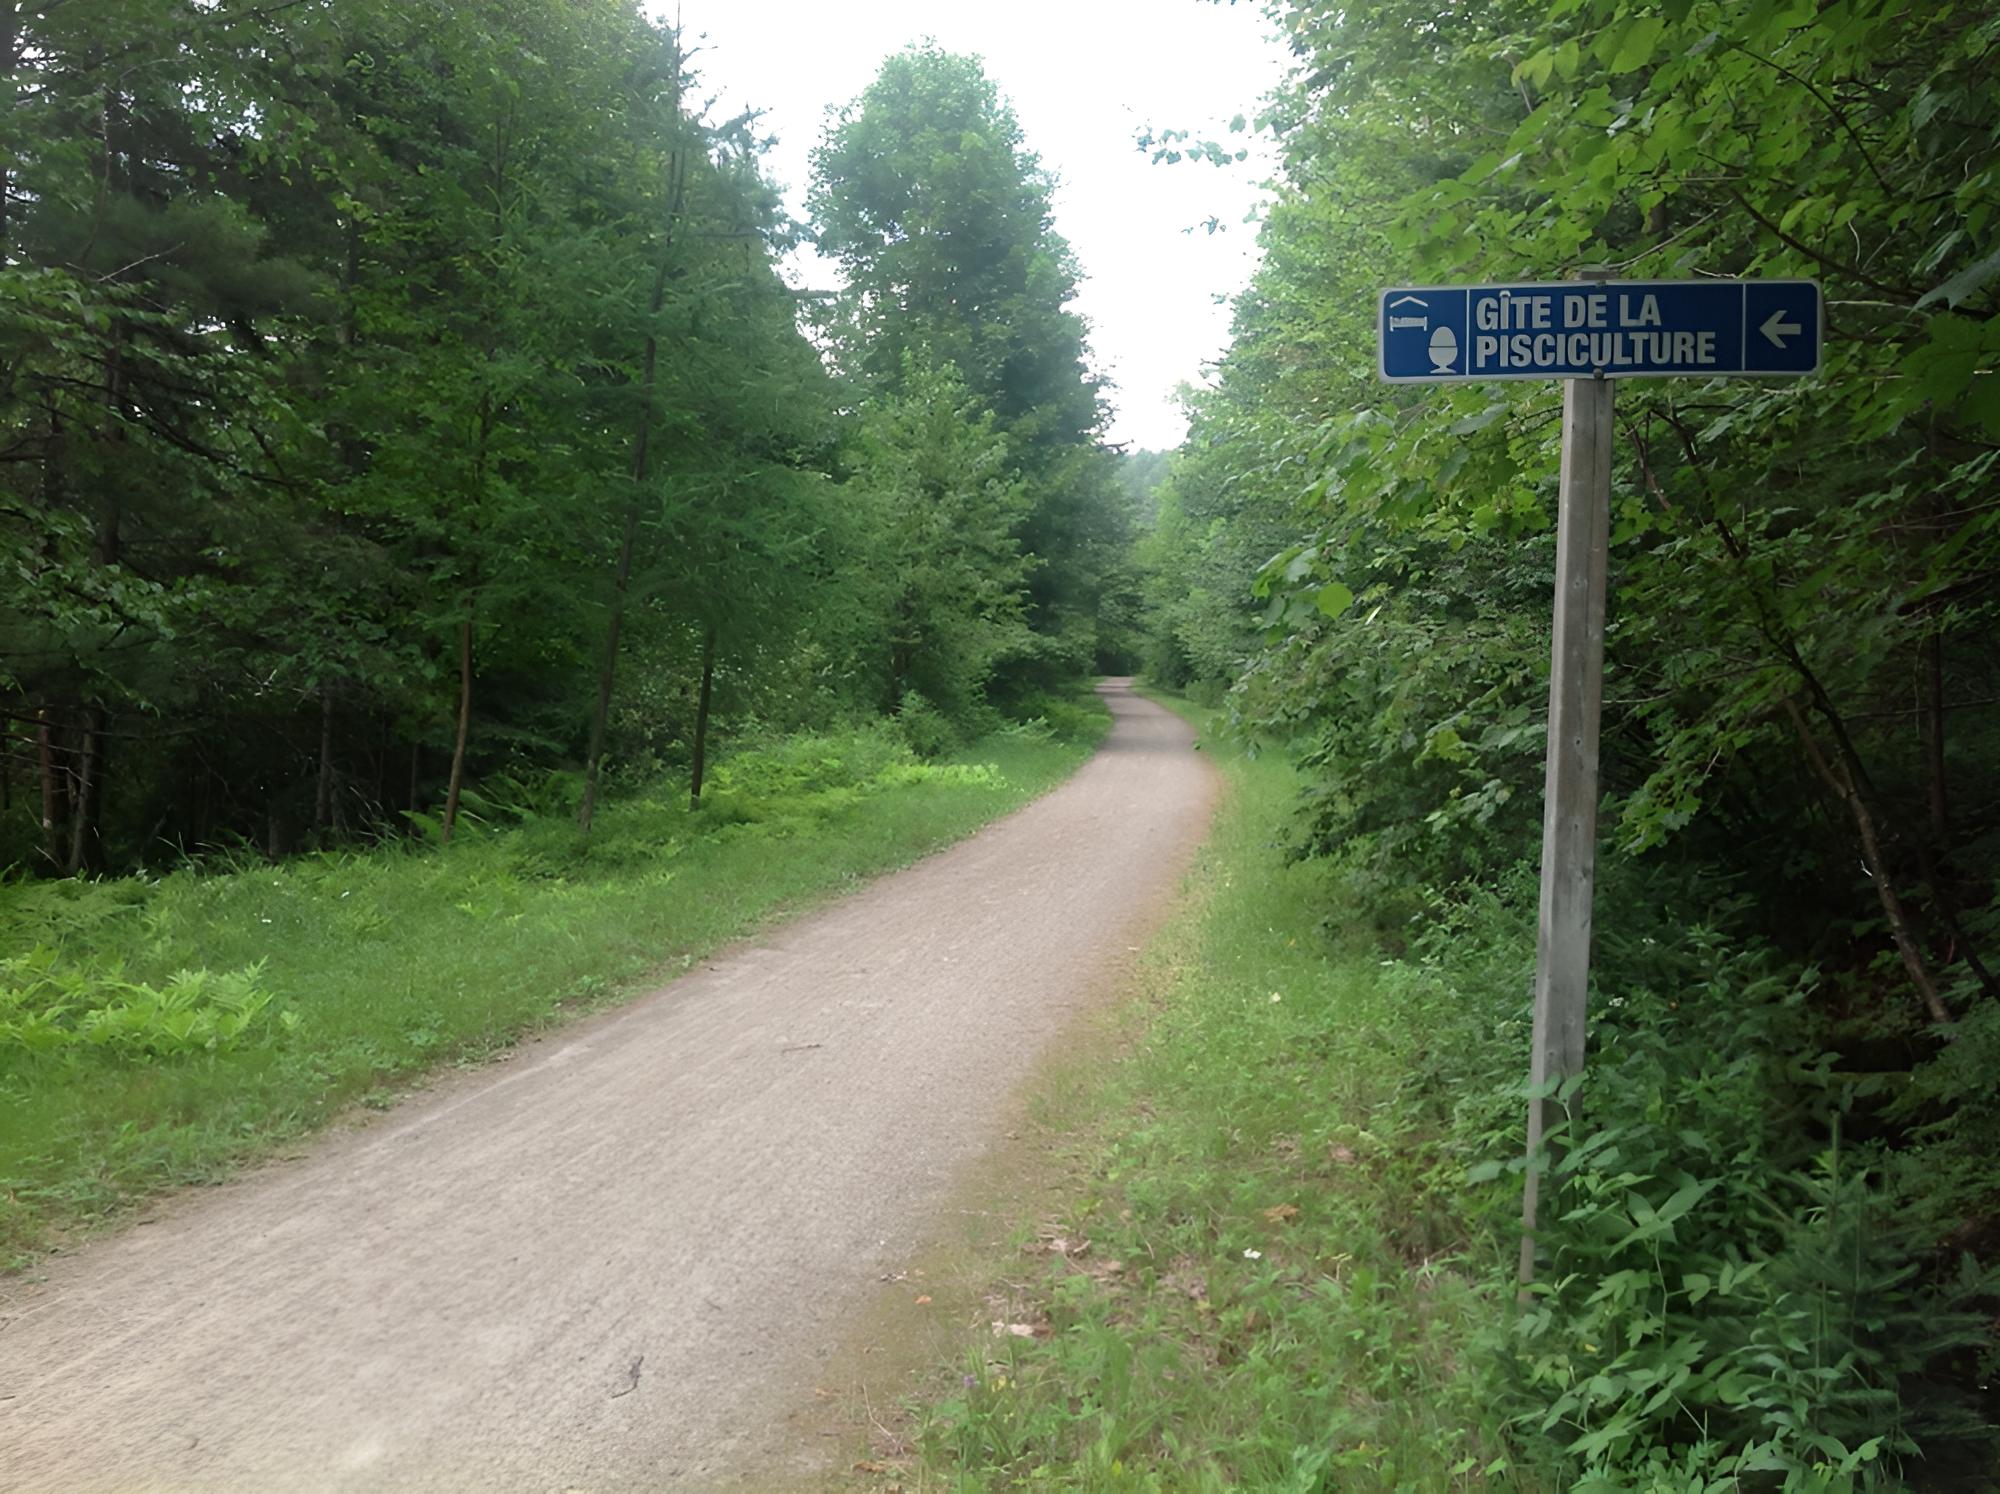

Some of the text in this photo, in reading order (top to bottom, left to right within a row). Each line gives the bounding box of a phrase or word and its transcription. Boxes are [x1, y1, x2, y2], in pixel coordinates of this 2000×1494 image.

[1564, 295, 1607, 328] DE
[1619, 294, 1662, 327] LA
[1476, 331, 1717, 368] PISCICULTURE
